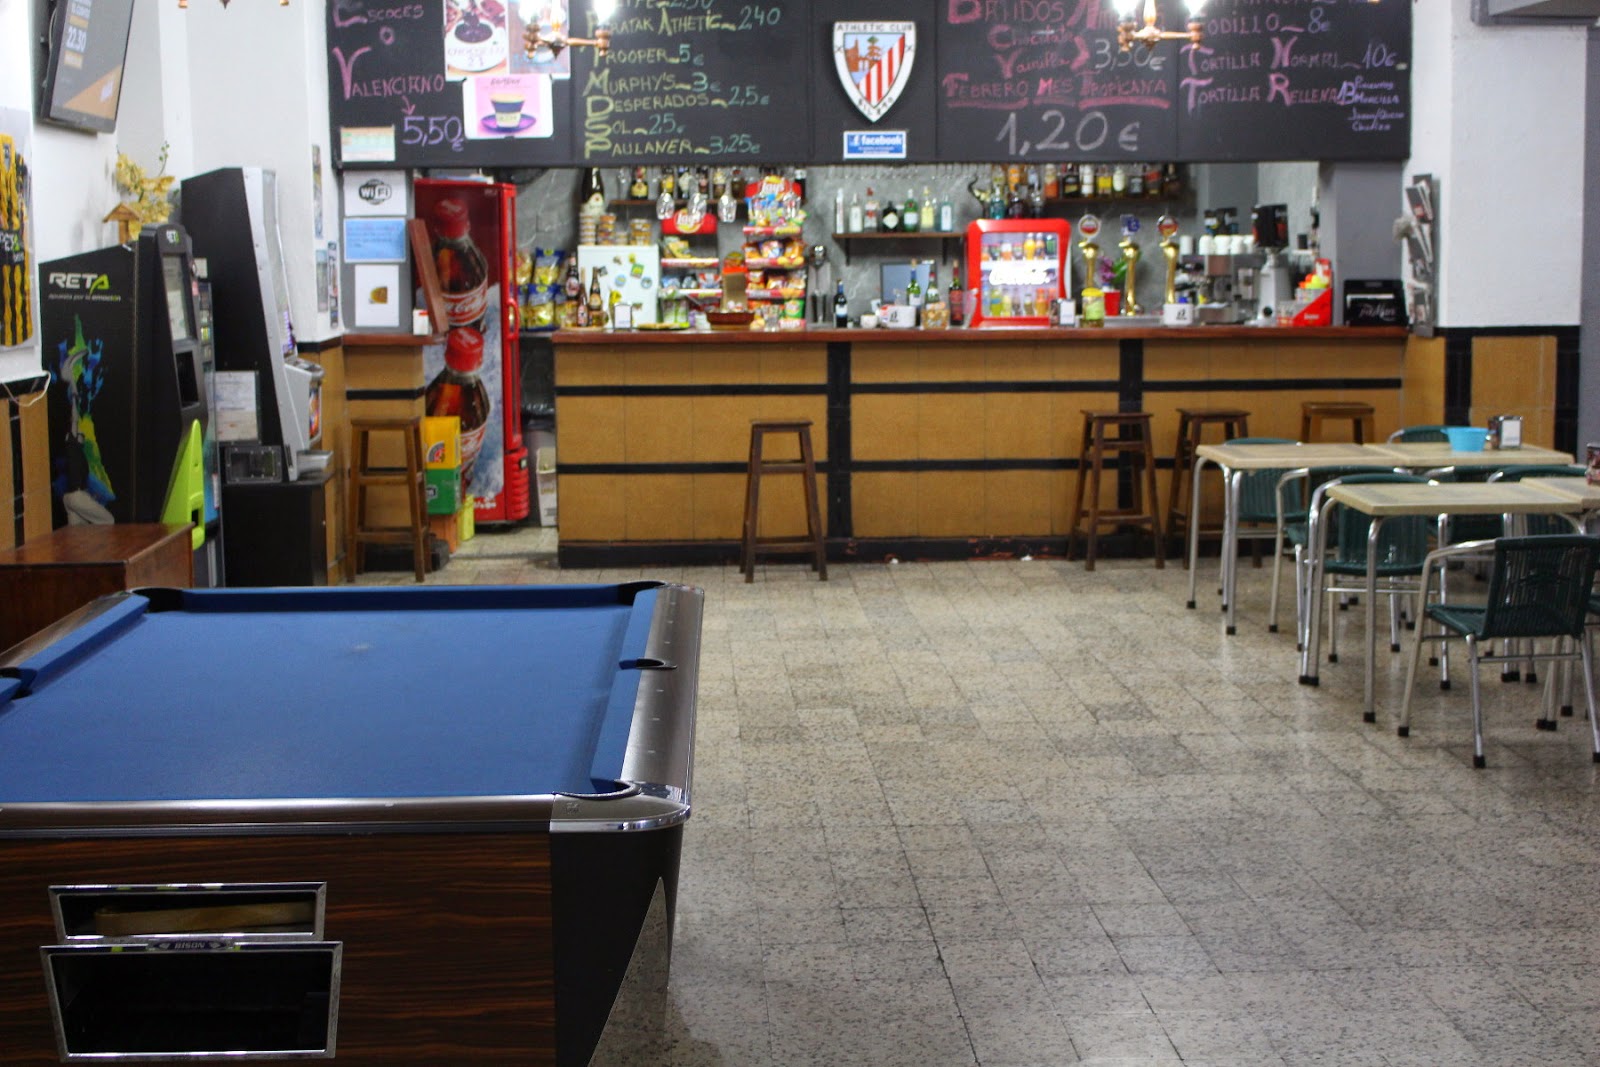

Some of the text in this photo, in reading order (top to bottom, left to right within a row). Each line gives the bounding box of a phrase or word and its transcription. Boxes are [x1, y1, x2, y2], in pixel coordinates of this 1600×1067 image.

[1190, 12, 1280, 36] ODILLO
[586, 95, 710, 118] DESPERADOS
[584, 136, 693, 159] PAULANER
[49, 272, 111, 294] RETA
